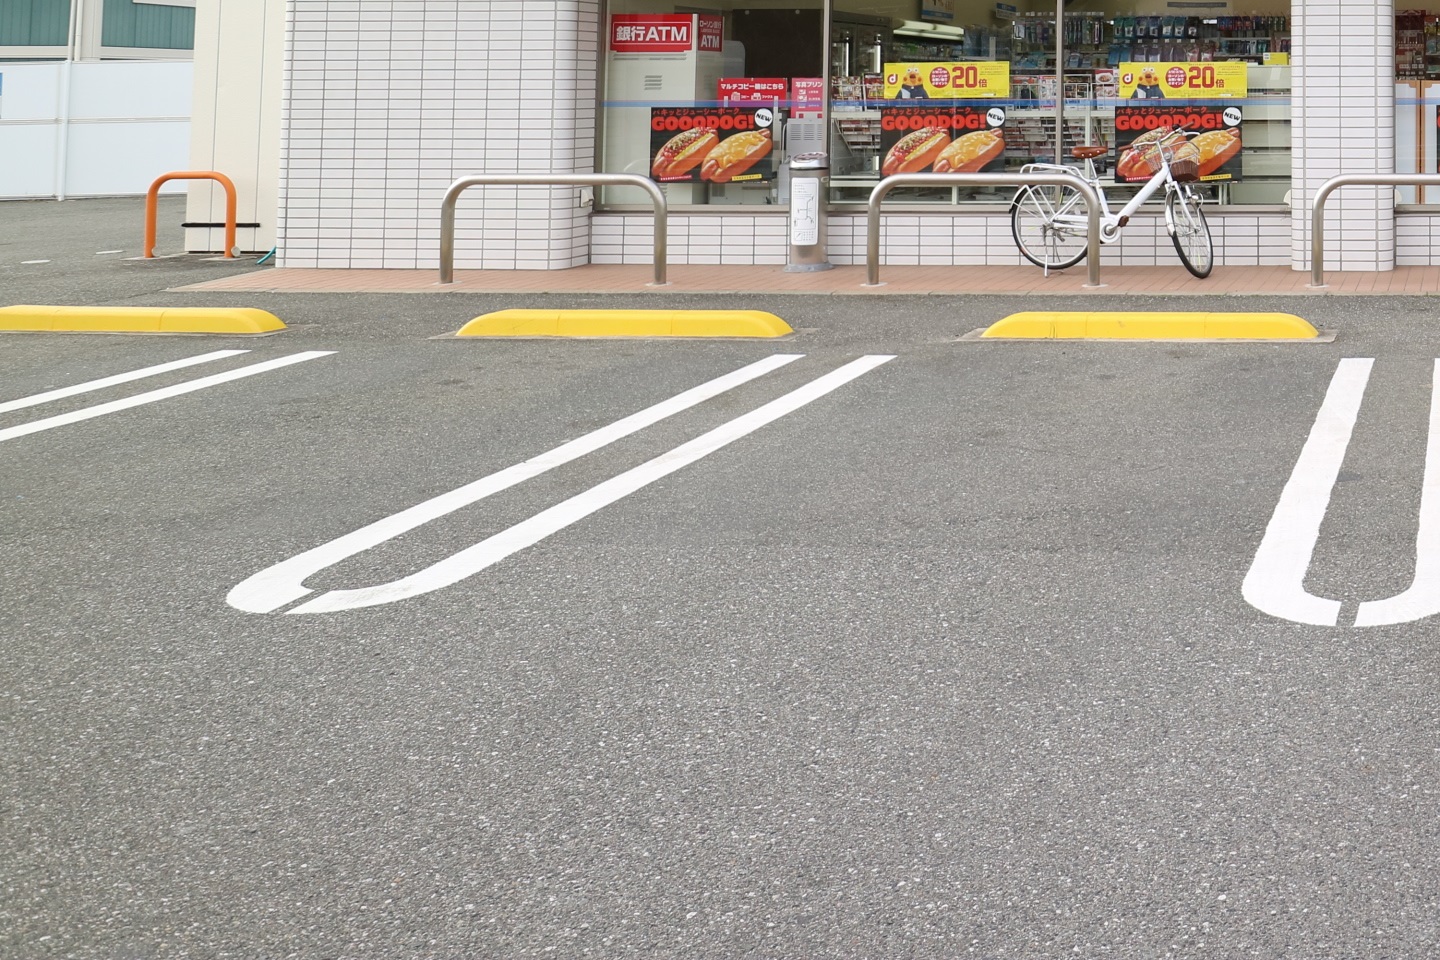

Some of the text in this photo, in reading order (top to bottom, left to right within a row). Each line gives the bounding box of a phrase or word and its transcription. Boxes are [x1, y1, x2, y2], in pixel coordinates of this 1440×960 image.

[616, 26, 688, 42] 銀行ATM
[700, 35, 720, 48] ATM
[653, 108, 740, 116] パキッとジューシーポーク
[882, 107, 971, 115] パキッとジューシーポーク
[1116, 106, 1207, 115] パキッとジューシーポーク
[755, 113, 772, 122] NEW
[988, 112, 1004, 122] NEW
[1224, 112, 1240, 121] NEW
[652, 115, 754, 131] GOOODOG!
[881, 114, 986, 131] GOOODOG!
[1115, 113, 1223, 131] GOOODOG!
